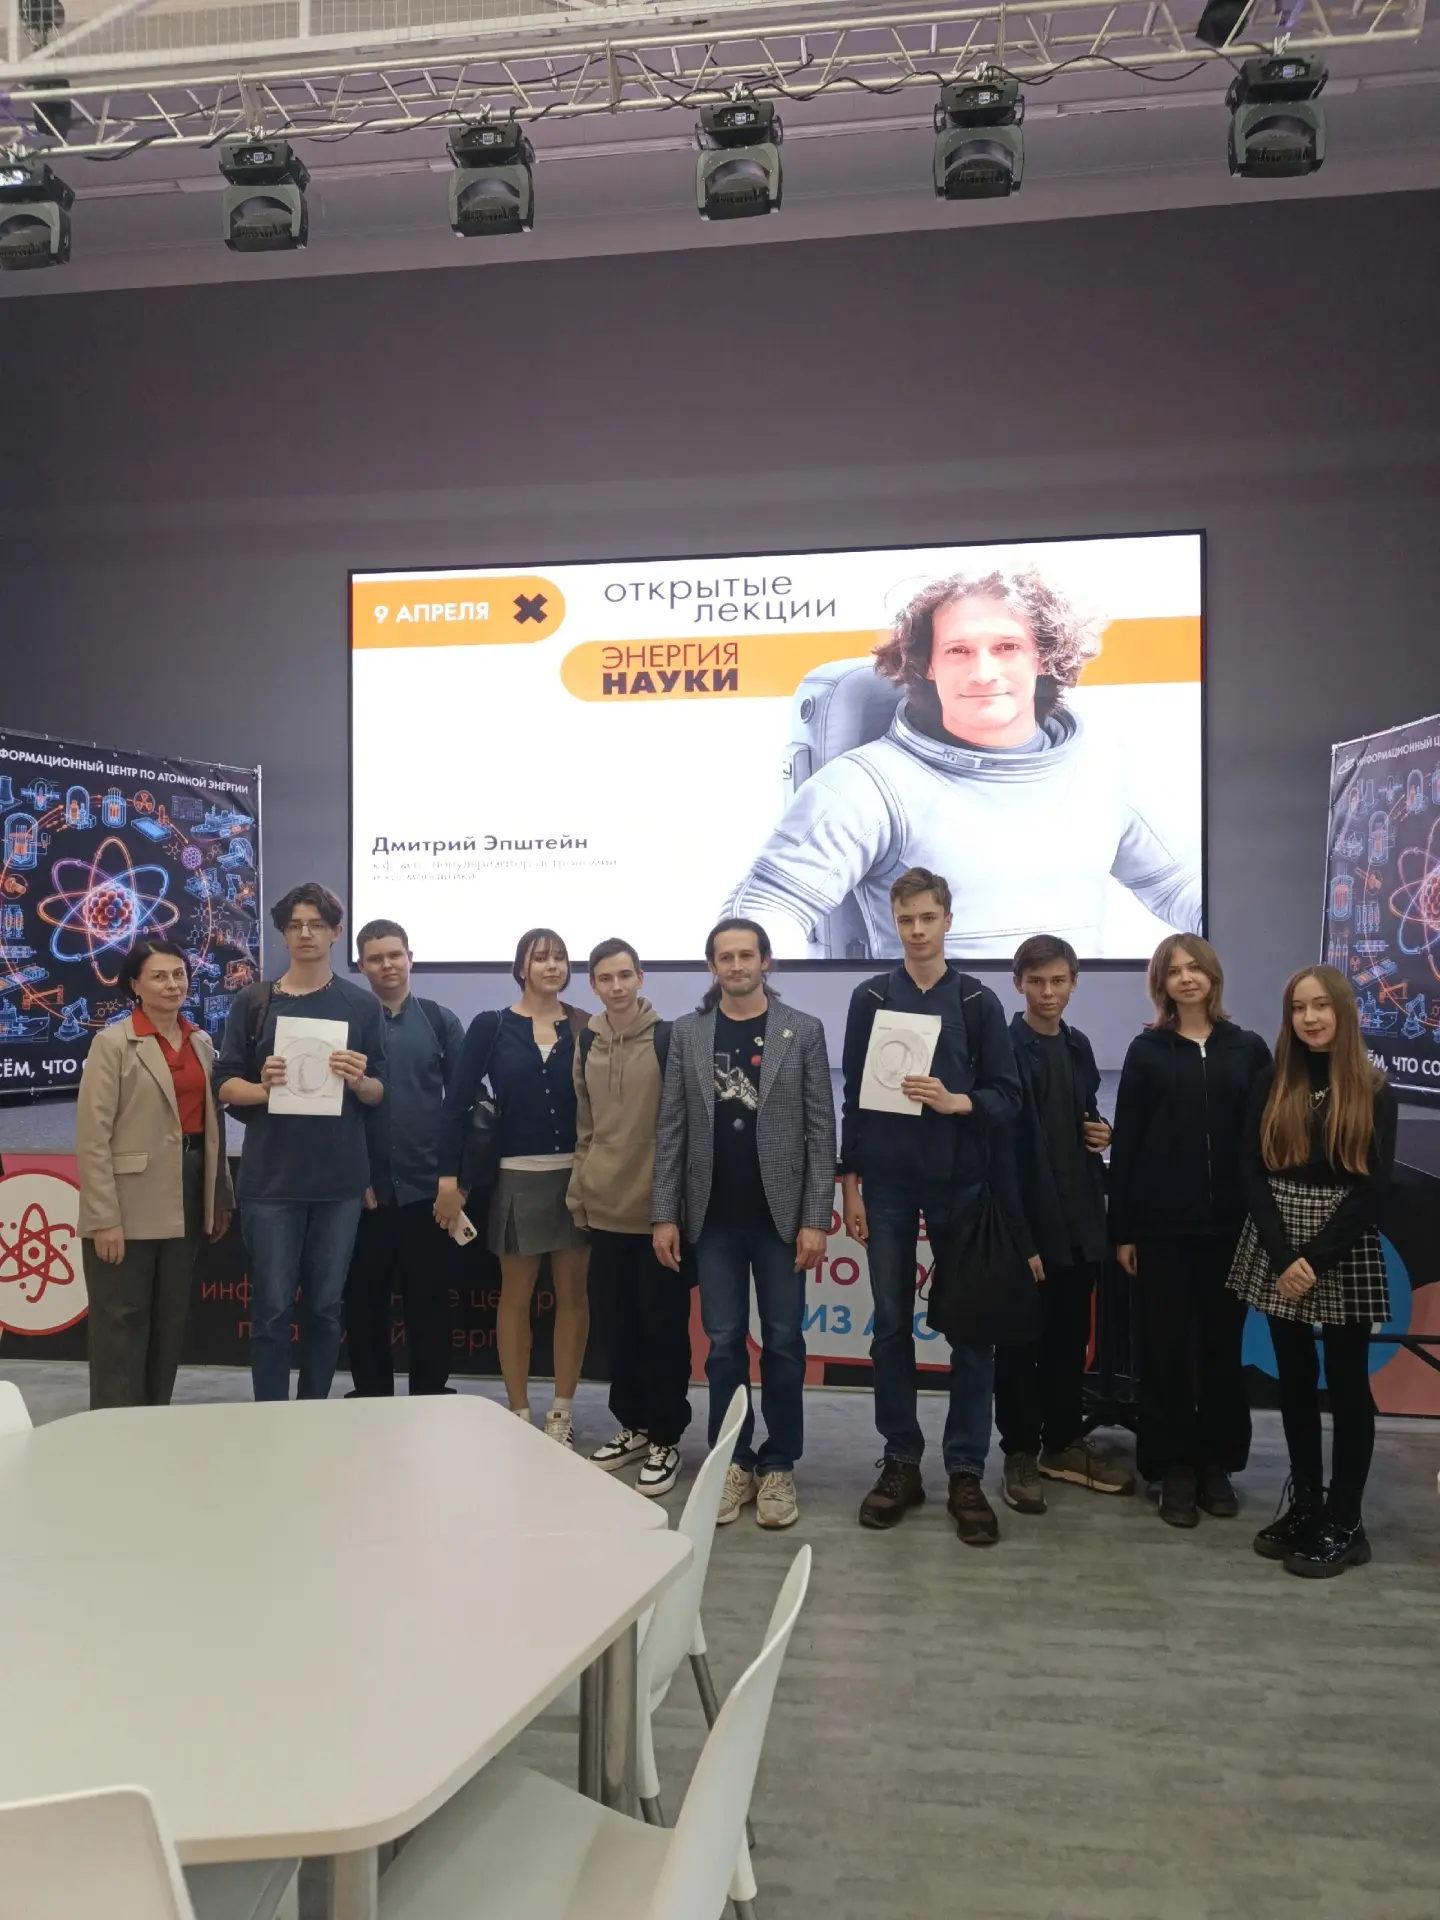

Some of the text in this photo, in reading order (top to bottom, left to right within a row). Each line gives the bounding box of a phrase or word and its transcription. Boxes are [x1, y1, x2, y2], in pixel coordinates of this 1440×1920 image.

[604, 575, 793, 610] открытые
[373, 601, 490, 624] 9 АПРЕЛЯ
[693, 598, 837, 624] лекции
[601, 641, 739, 669] ЭНЕРГИЯ
[602, 668, 739, 696] НАУКИ
[106, 763, 138, 778] ЦЕНТР
[140, 769, 156, 780] ПО
[158, 771, 207, 788] АТОМНОЙ
[208, 780, 249, 794] ЭНЕРГИИ
[371, 834, 589, 856] Дмитрий Эпштейн
[0, 1058, 36, 1078] ЁМ,
[42, 1059, 77, 1075] ЧТО
[1392, 1056, 1419, 1073] ЧТО
[813, 1256, 860, 1286] ТО
[801, 1304, 852, 1335] ИЗ
